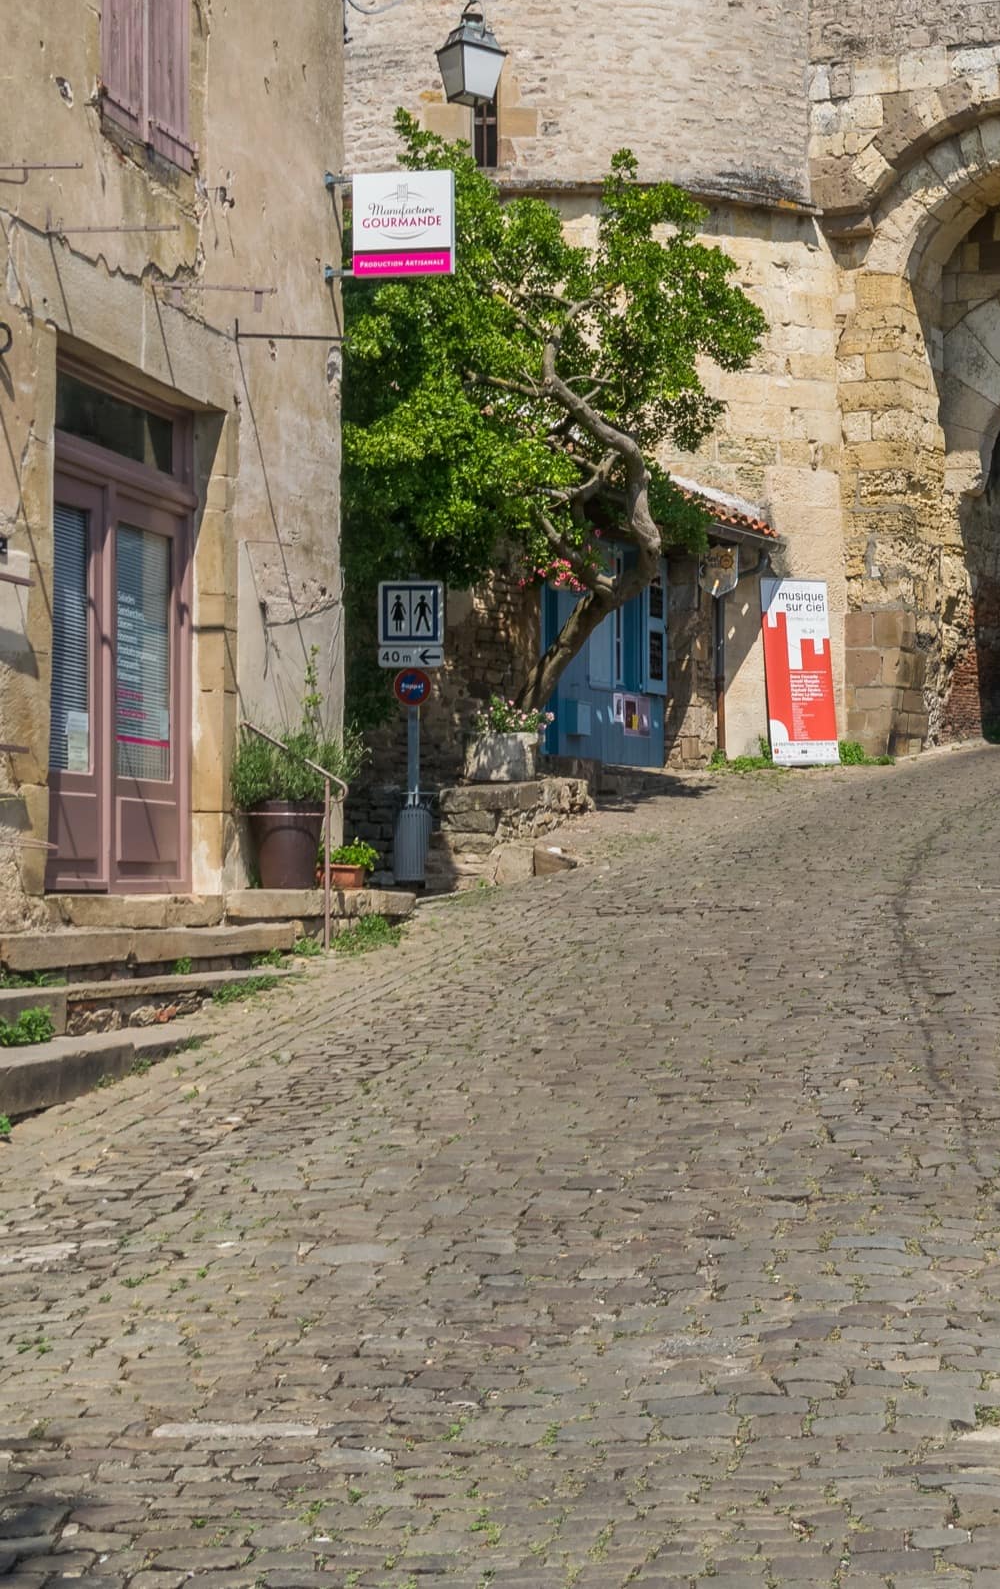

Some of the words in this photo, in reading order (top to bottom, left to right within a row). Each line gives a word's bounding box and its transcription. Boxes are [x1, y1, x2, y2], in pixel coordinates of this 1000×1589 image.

[368, 203, 435, 219] Manufacture
[362, 215, 442, 229] GOURMANDE
[360, 261, 404, 269] PRODUCTION
[405, 258, 444, 267] ARTISANALE
[778, 591, 824, 603] musique
[785, 603, 803, 612] sur
[806, 602, 825, 613] ciel
[382, 650, 400, 663] 40
[402, 654, 412, 663] m
